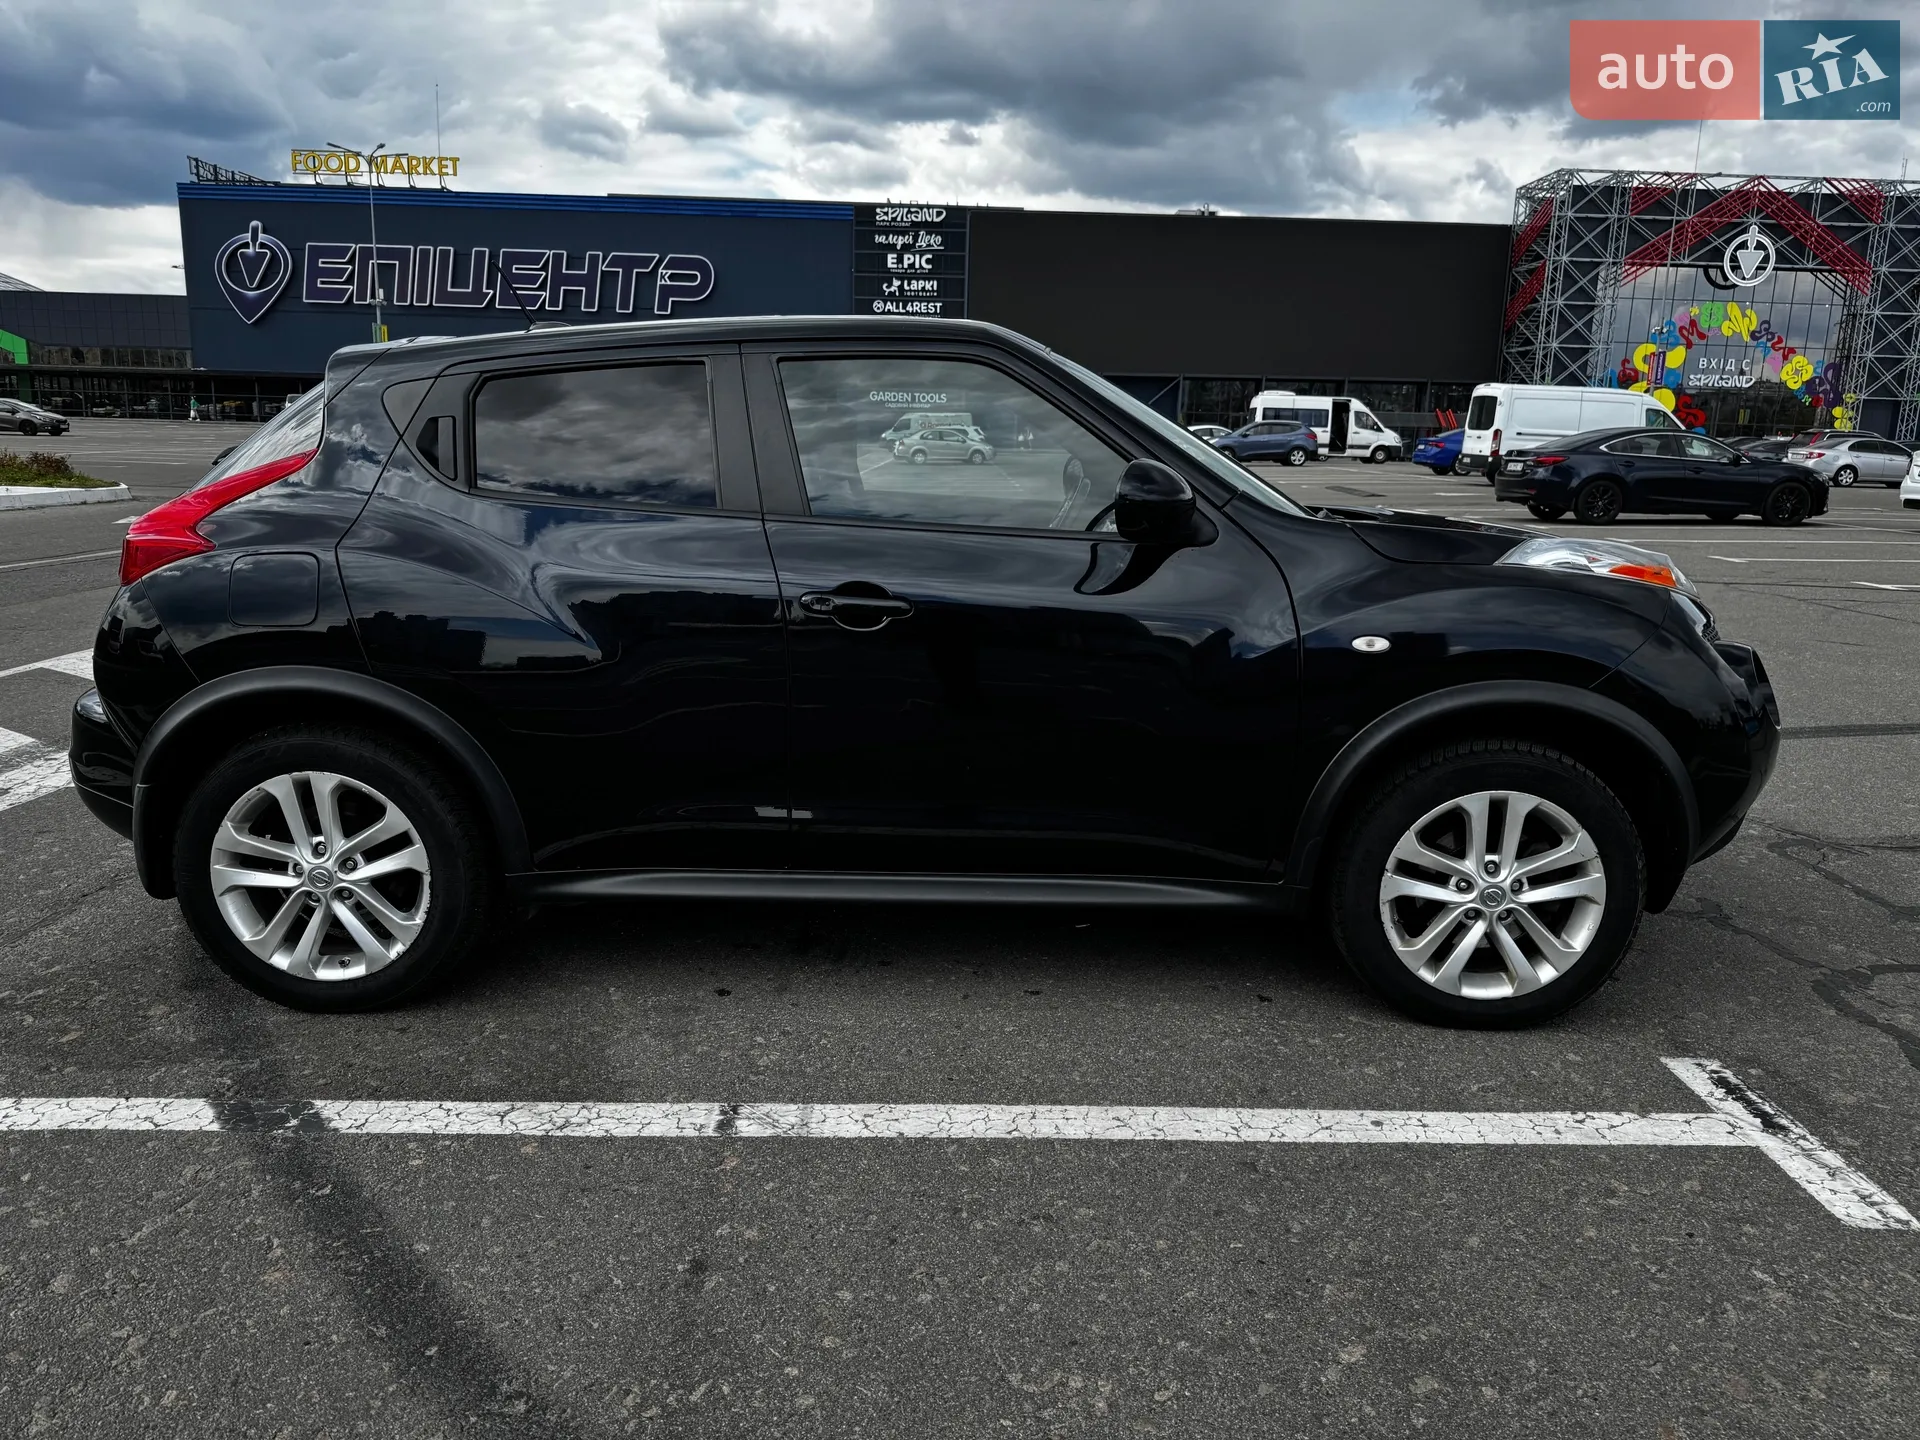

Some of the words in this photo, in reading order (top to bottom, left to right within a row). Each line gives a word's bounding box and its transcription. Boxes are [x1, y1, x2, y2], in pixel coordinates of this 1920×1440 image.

[291, 152, 361, 173] FOOD
[370, 154, 460, 176] MARKET
[874, 231, 915, 250] галереї
[915, 230, 943, 250] Деко
[887, 253, 933, 269] E.PIC
[303, 243, 714, 314] ЕПІЦЕНТР
[884, 301, 942, 313] ALL4REST
[1698, 357, 1735, 371] ВХІД
[869, 391, 912, 403] GARDEN
[914, 392, 947, 403] TOOLS
